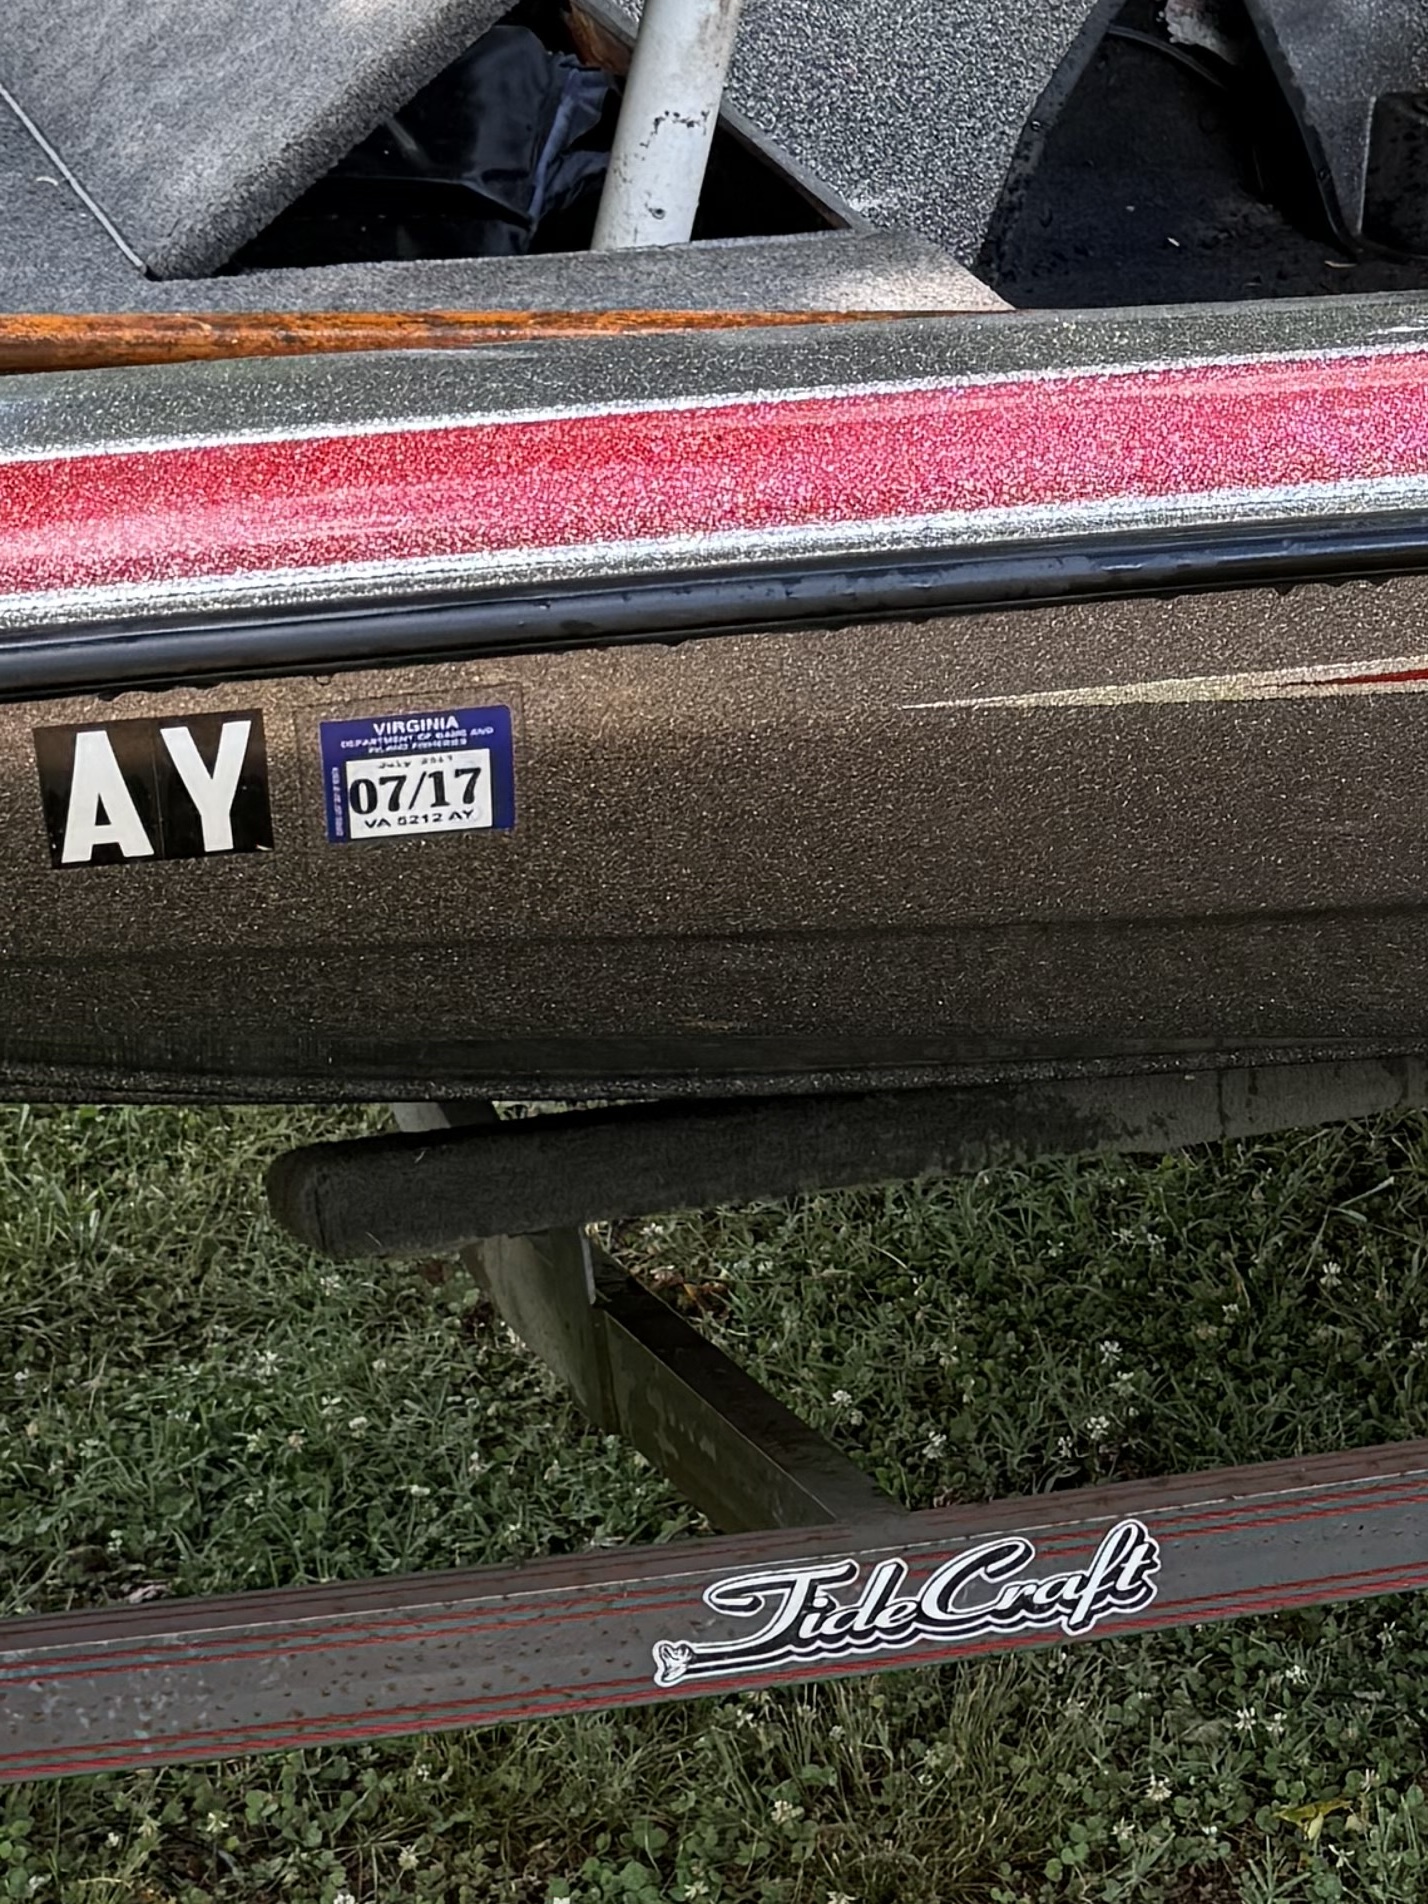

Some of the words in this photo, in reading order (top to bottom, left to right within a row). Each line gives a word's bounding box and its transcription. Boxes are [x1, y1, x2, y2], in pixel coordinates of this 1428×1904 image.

[372, 715, 460, 735] VIRGINIA
[61, 720, 251, 864] AY
[349, 767, 482, 815] 07/17
[364, 817, 391, 829] VA
[448, 808, 474, 821] AY
